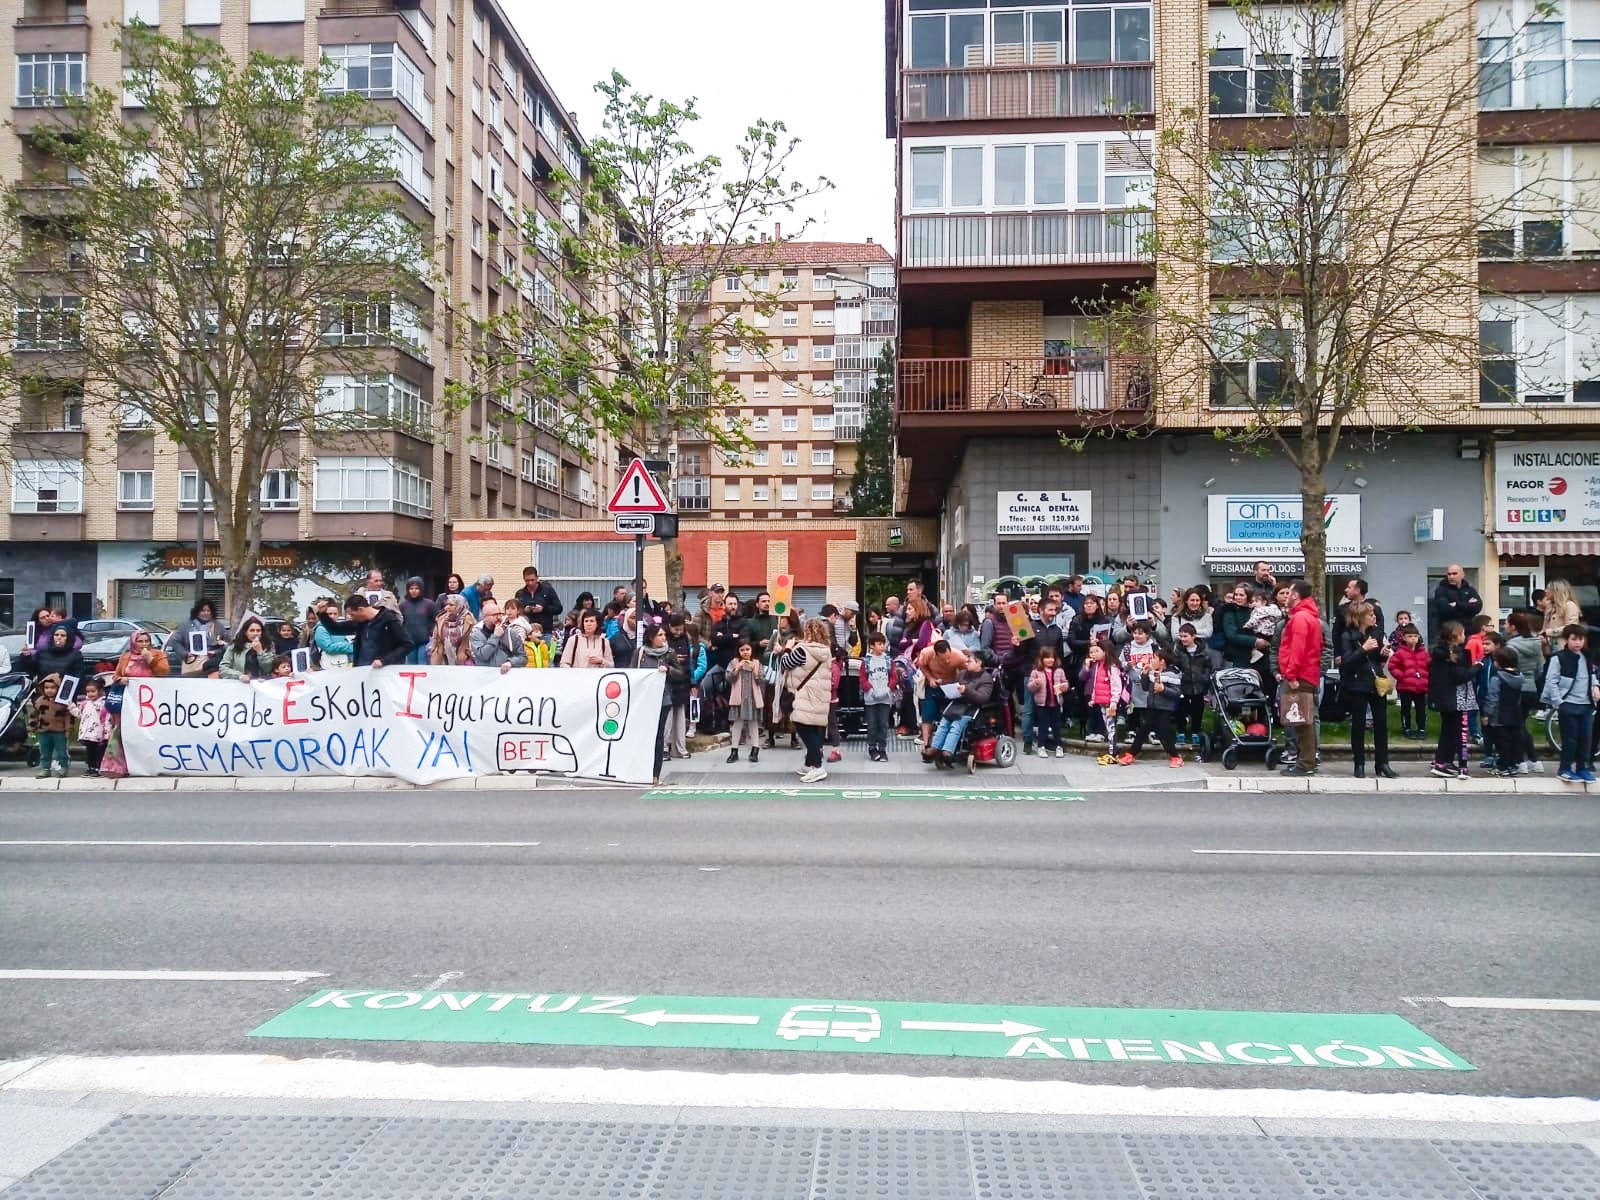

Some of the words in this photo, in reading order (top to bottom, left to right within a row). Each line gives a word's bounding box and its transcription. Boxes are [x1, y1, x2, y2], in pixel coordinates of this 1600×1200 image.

[1506, 480, 1545, 489] FAGOR
[1017, 493, 1028, 502] C.
[1039, 493, 1049, 502] &
[1061, 493, 1072, 502] L.
[1239, 503, 1279, 519] am
[1238, 530, 1276, 538] aluminio
[171, 557, 195, 567] CASA
[138, 684, 274, 738] Babesgabe
[396, 672, 561, 732] Inguruan
[159, 727, 391, 773] SEMAFOROAK
[417, 730, 473, 772] YA!
[504, 740, 549, 761] BEI
[307, 989, 639, 1014] KONTUZ
[1004, 1036, 1456, 1069] ATENCIÓN
